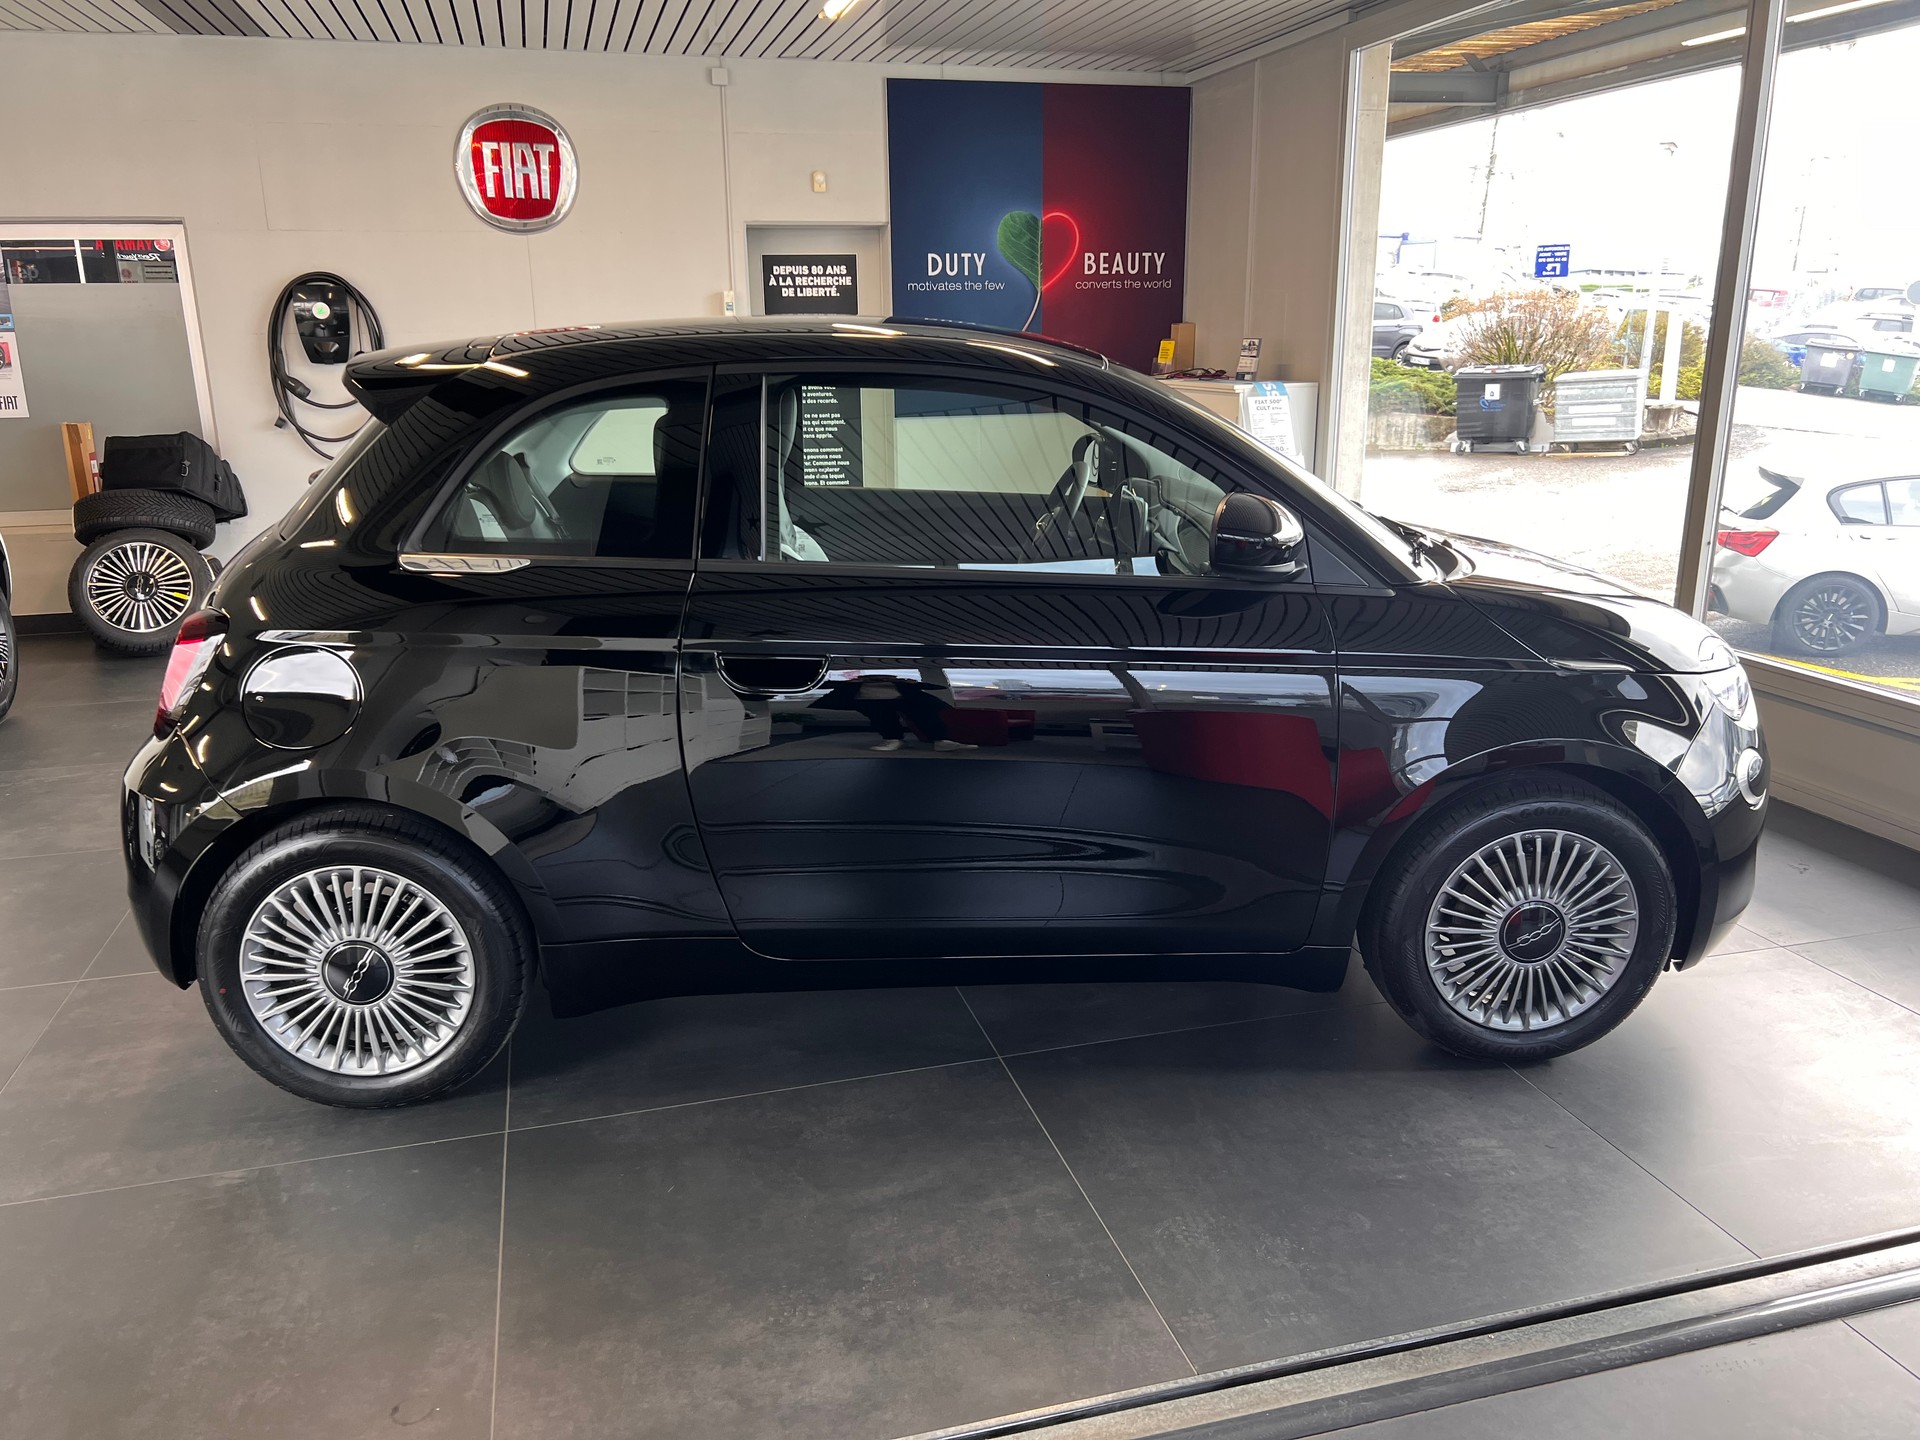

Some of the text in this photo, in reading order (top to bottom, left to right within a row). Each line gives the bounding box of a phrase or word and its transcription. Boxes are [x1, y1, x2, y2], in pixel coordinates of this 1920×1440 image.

[482, 141, 555, 200] FIAT
[927, 252, 986, 277] DUTY
[1083, 252, 1166, 275] BEAUTY
[772, 265, 847, 275] DEPUIS 80 ANS
[768, 274, 852, 286] À LA RECHERCHE
[907, 280, 1005, 291] motivates the few
[1075, 279, 1172, 290] converts the world
[781, 285, 840, 297] DE LIBERTÉ.
